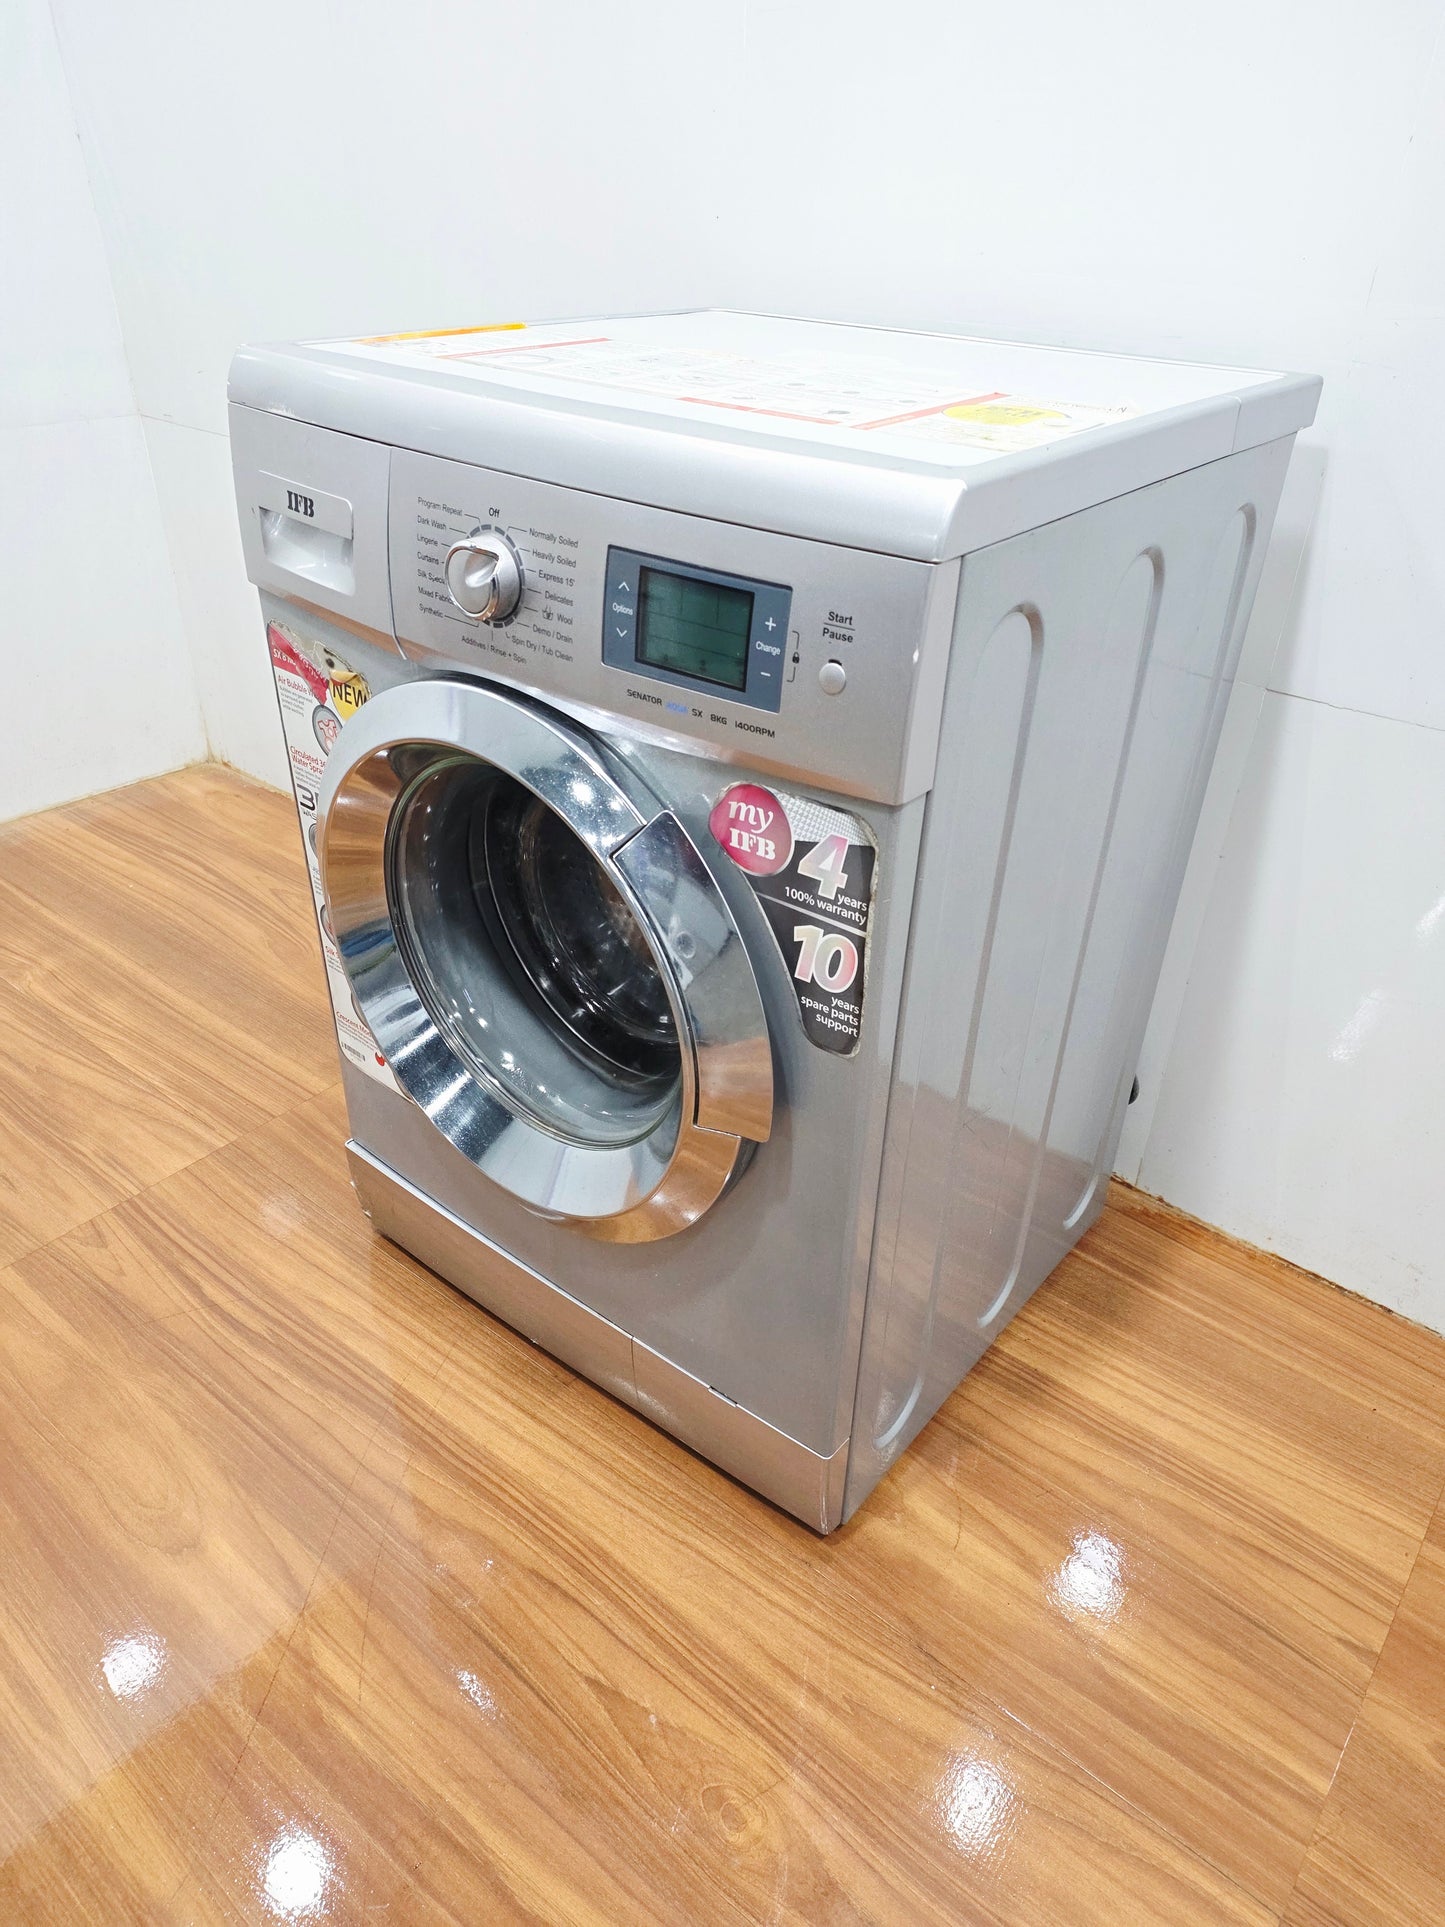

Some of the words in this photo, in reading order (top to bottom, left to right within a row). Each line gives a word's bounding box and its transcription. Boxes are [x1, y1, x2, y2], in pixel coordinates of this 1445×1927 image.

[287, 490, 315, 518] IFB
[417, 496, 441, 511] Program
[442, 504, 463, 516] Repeat
[488, 507, 500, 518] Off
[417, 515, 430, 526] Dark
[431, 519, 447, 531] Wash
[417, 533, 439, 547] Lingerie
[529, 528, 557, 544] Normally
[558, 535, 579, 548] Soiled
[417, 551, 439, 565] Curtains
[532, 548, 555, 564] Heavily
[556, 555, 577, 568] Soiled
[538, 569, 564, 585] Express
[418, 586, 434, 598] Mixed
[545, 590, 574, 607] Delicates
[419, 603, 444, 618] Synthetic
[557, 613, 573, 625] Wool
[612, 602, 634, 617] Options
[828, 611, 853, 626] Start
[533, 624, 551, 638] Demo
[556, 632, 574, 645] Drain
[822, 627, 854, 643] Pause
[462, 635, 486, 651] Additives
[490, 645, 507, 658] Rinse
[513, 653, 527, 665] Spin
[512, 635, 525, 648] Spin
[526, 640, 537, 652] Dry
[542, 645, 553, 657] Tub
[555, 650, 574, 663] Clean
[755, 640, 781, 656] Change
[332, 683, 367, 708] NEW
[627, 688, 663, 706] SENATOR
[691, 708, 703, 718] SX
[710, 713, 728, 725] 8KG
[735, 720, 776, 739] 1400RPM
[728, 800, 774, 834] my
[729, 827, 777, 861] IFB
[797, 832, 850, 900] 4
[837, 893, 868, 912] years
[784, 886, 815, 906] 100%
[817, 900, 867, 926] warranty
[793, 924, 859, 994] 10
[800, 996, 829, 1014] spare
[831, 1008, 859, 1026] parts
[831, 996, 860, 1015] years
[815, 1013, 858, 1038] support
